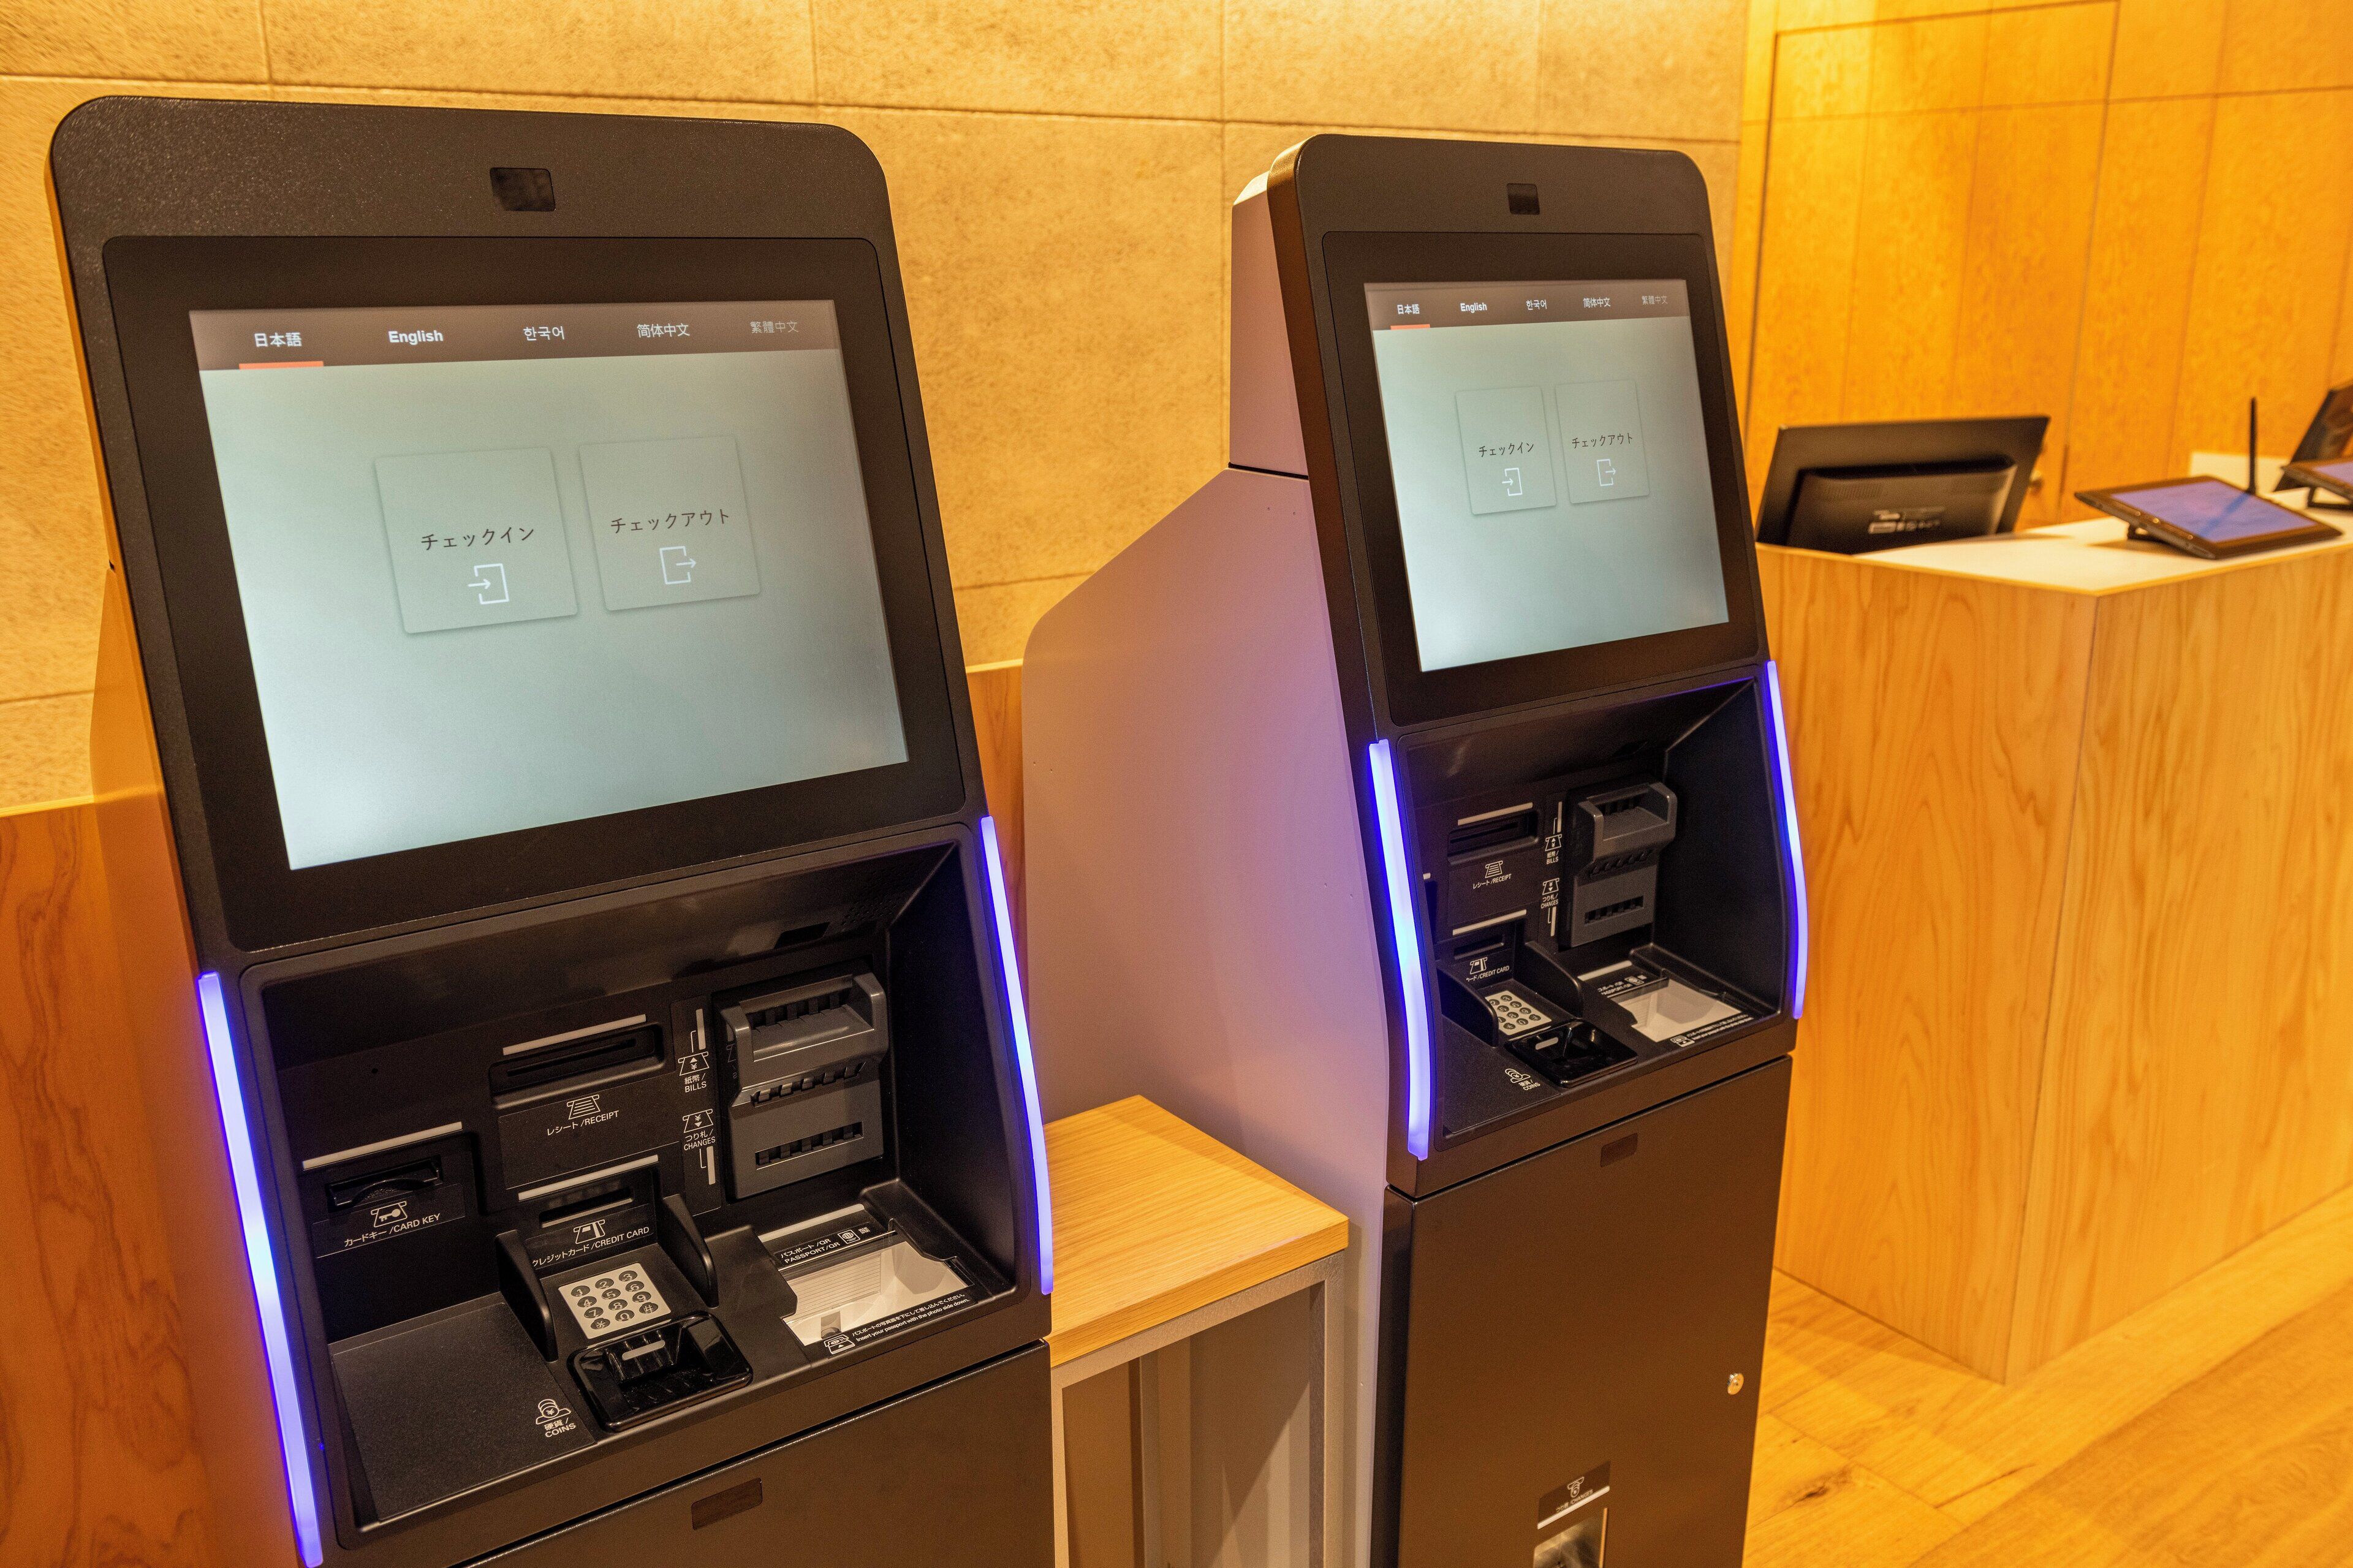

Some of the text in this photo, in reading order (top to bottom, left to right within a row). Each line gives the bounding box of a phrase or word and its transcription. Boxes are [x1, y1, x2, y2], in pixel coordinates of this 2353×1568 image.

[1396, 304, 1420, 315] 日本語
[1460, 302, 1488, 314] English
[1525, 299, 1547, 311] 한국어
[1583, 297, 1611, 308] 简体中文
[523, 325, 565, 341] 한국어
[636, 323, 690, 338] 简体中文
[749, 320, 798, 334] 繁體中文
[254, 331, 303, 347] 日本語
[388, 330, 444, 346] English
[1571, 432, 1632, 449] チェックアウト
[1478, 441, 1534, 458] チェックイン
[610, 508, 730, 534] チェックアウト
[420, 526, 535, 551] チェックイン
[1546, 856, 1559, 865] BILLS
[1472, 879, 1490, 890] レシート
[1540, 899, 1559, 909] CHANGES
[1496, 965, 1510, 974] CARD
[684, 1081, 707, 1093] BILLS
[547, 1121, 578, 1136] レシート
[683, 1136, 716, 1151] CHANGES
[344, 1230, 387, 1248] カードキー
[422, 1213, 441, 1225] KEY
[532, 1244, 590, 1267] クレジットカード
[626, 1226, 650, 1239] CARD
[784, 1241, 841, 1263] PASSPORT/QR
[583, 1298, 593, 1307] 4
[605, 1291, 615, 1300] 5
[613, 1301, 623, 1310] 8
[636, 1294, 646, 1303] 9
[855, 1333, 873, 1342] Insert
[884, 1320, 907, 1332] passport
[927, 1308, 943, 1316] photo
[545, 1423, 577, 1438] COINS
